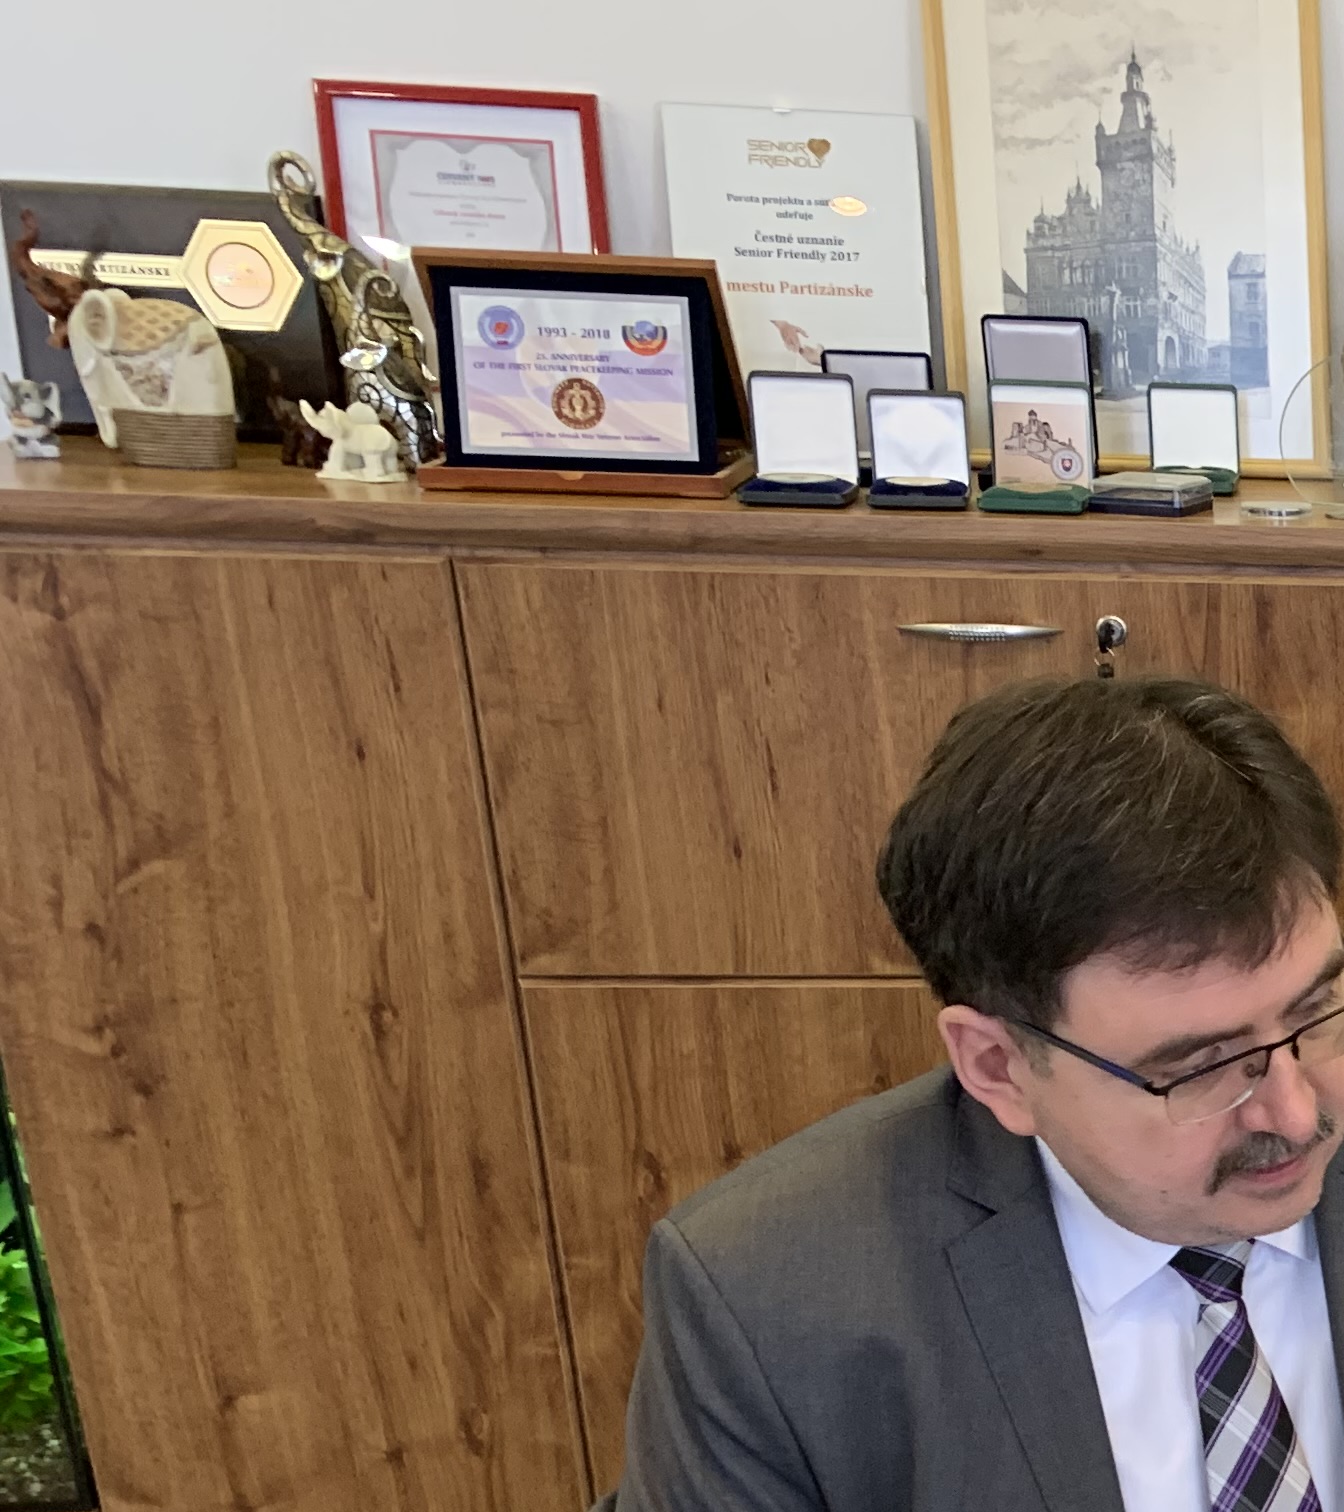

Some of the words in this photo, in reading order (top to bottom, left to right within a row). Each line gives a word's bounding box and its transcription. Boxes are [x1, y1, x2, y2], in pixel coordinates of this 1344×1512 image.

[747, 139, 808, 155] SENIOR
[748, 153, 825, 168] FRIENDLY
[754, 230, 794, 244] Čestné
[797, 236, 844, 246] uznanie
[734, 247, 773, 258] Senior
[776, 249, 827, 262] Friendly
[830, 251, 860, 262] 2017
[92, 263, 171, 276] ARTIZÁNSKE
[726, 281, 775, 294] mestu
[779, 281, 874, 298] Partizánske
[537, 326, 568, 338] 1993
[581, 328, 611, 339] 2018
[635, 367, 673, 376] MISSION
